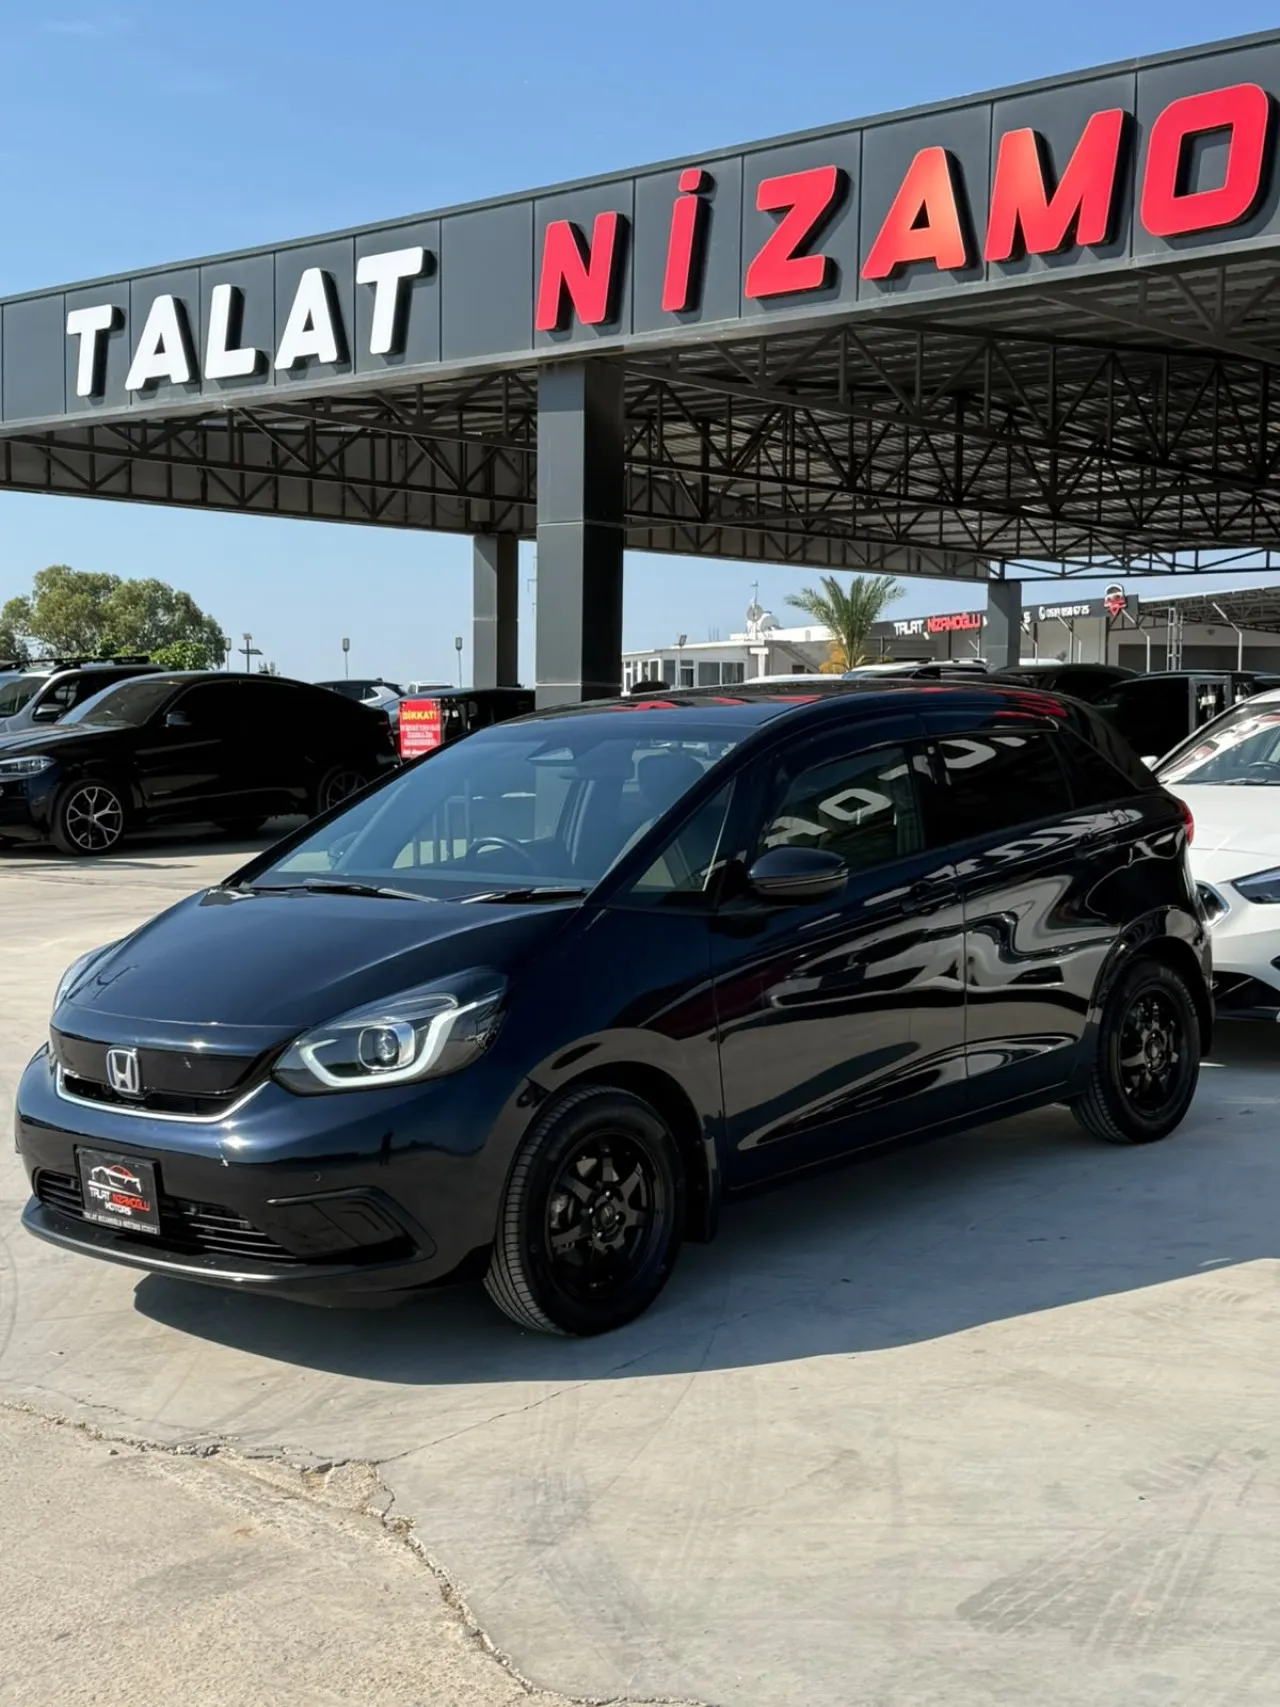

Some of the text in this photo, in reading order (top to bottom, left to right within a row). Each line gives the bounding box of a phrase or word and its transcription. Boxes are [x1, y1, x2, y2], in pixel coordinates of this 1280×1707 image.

[66, 83, 1271, 397] TALAT NİZAMO
[893, 619, 924, 636] TALAT
